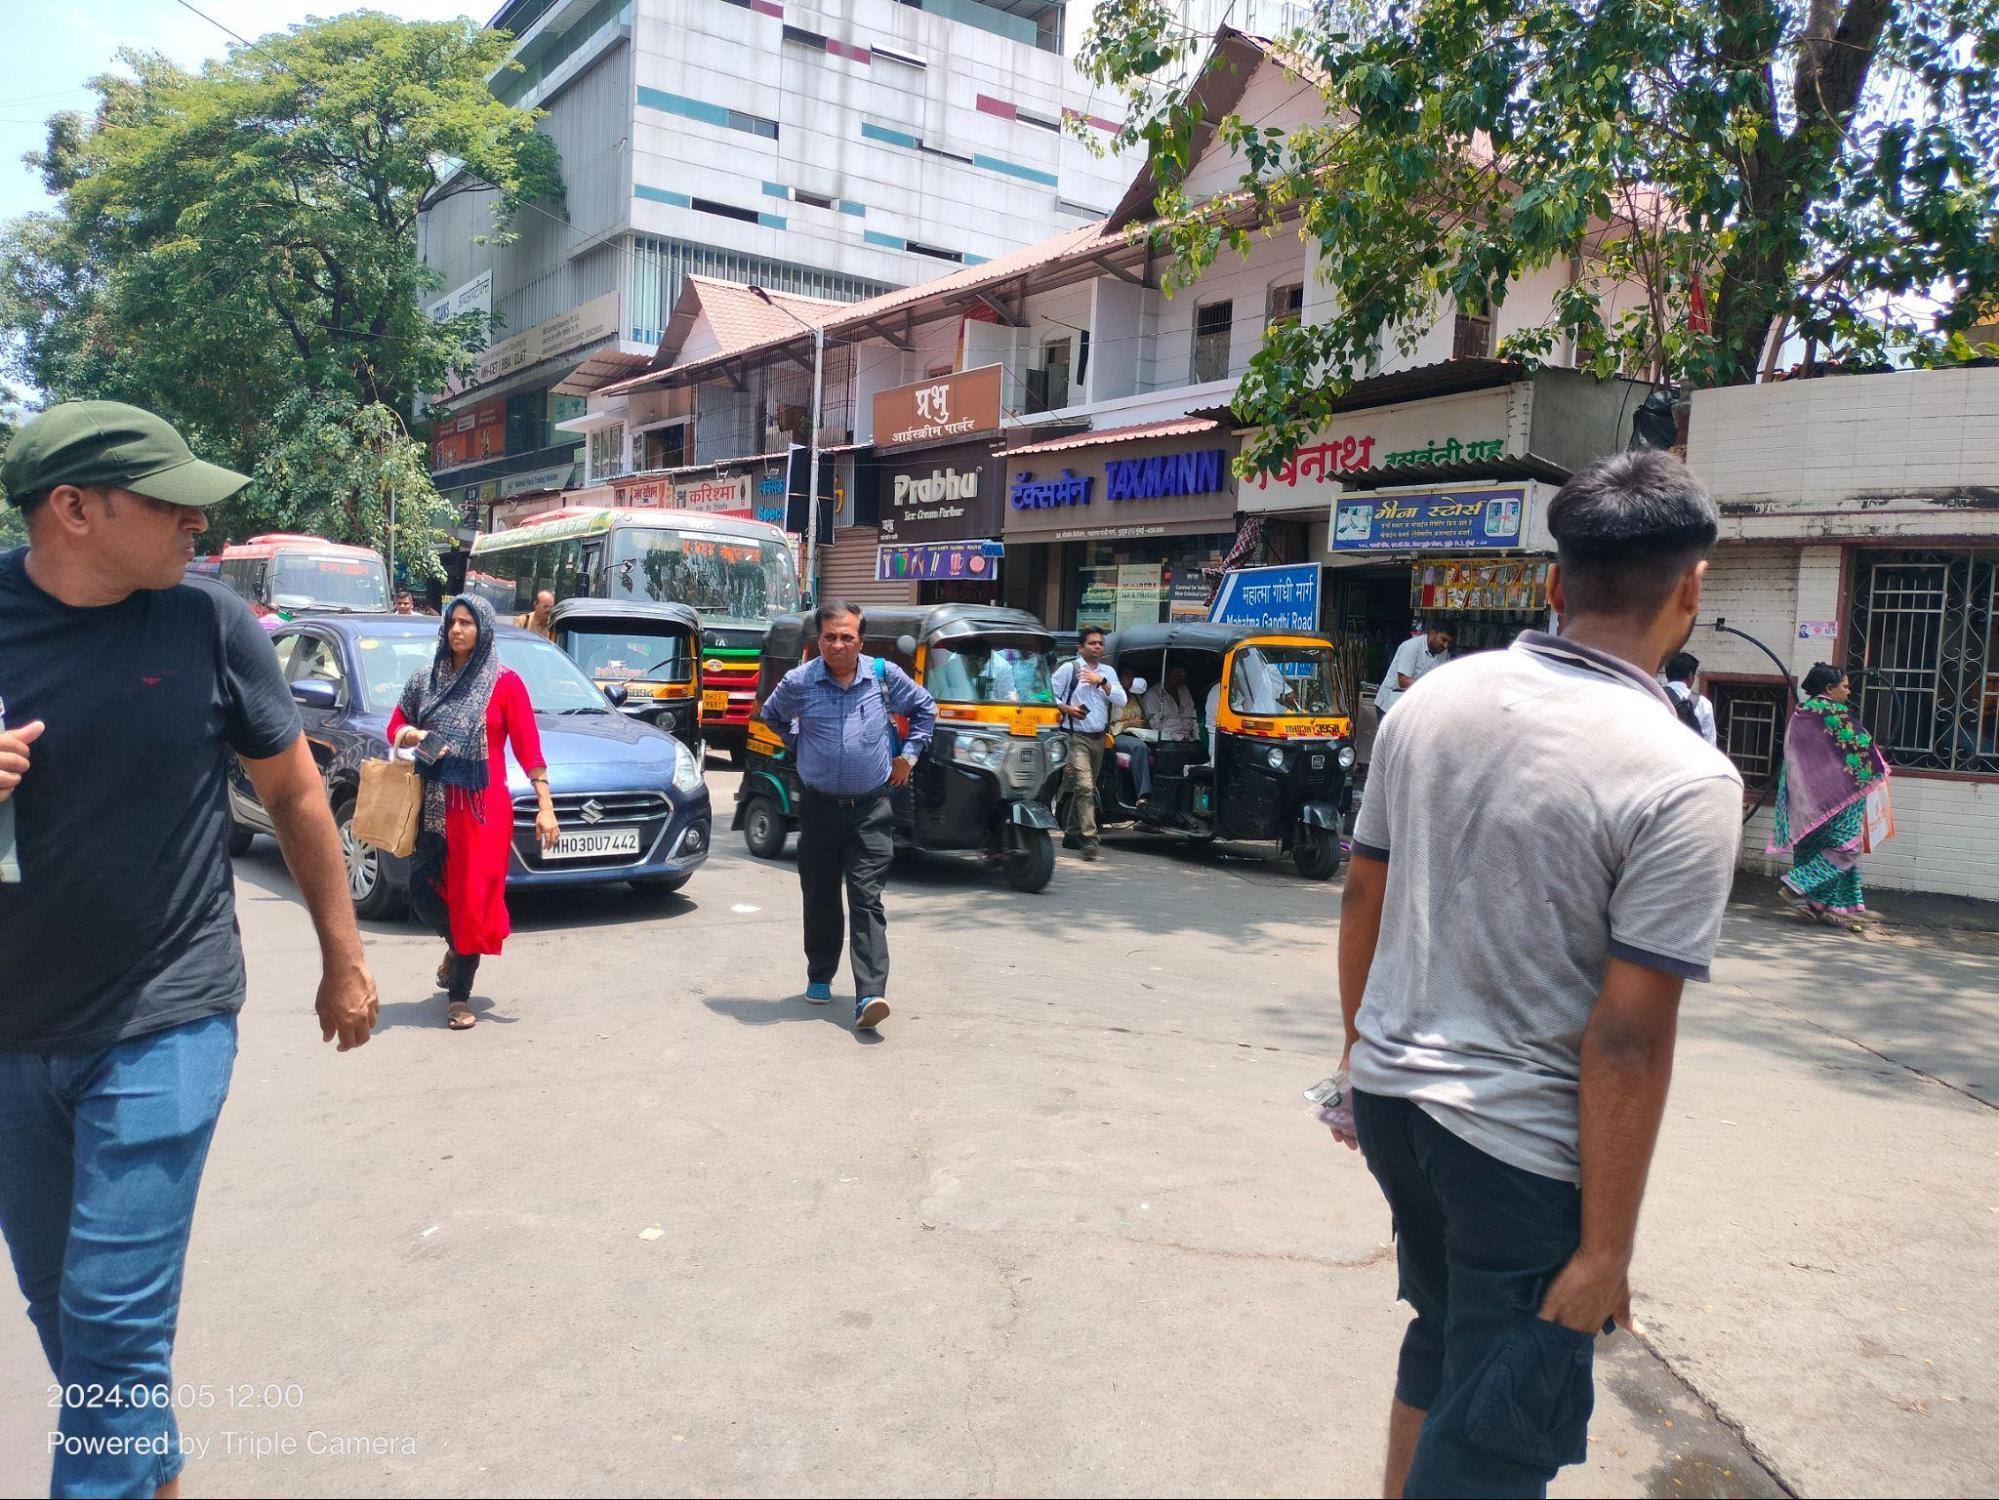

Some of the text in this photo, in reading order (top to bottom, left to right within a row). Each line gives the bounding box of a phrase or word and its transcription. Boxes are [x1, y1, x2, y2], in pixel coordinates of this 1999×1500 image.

[915, 383, 950, 425] प्रभु
[891, 417, 976, 442] आईस्क्रीम पार्लर
[1466, 438, 1505, 460] गह
[1105, 449, 1224, 500] TAXMANN
[689, 482, 737, 505] करिश्मा
[894, 467, 978, 506] Prabhu
[904, 510, 916, 521] Ice
[917, 508, 938, 520] Cream
[1374, 499, 1419, 520] मीना
[1242, 574, 1314, 606] महात्मा गांधी मार्ग
[1226, 611, 1313, 631] Mahatma Gandhi Road
[552, 834, 636, 855] MH03DU7442
